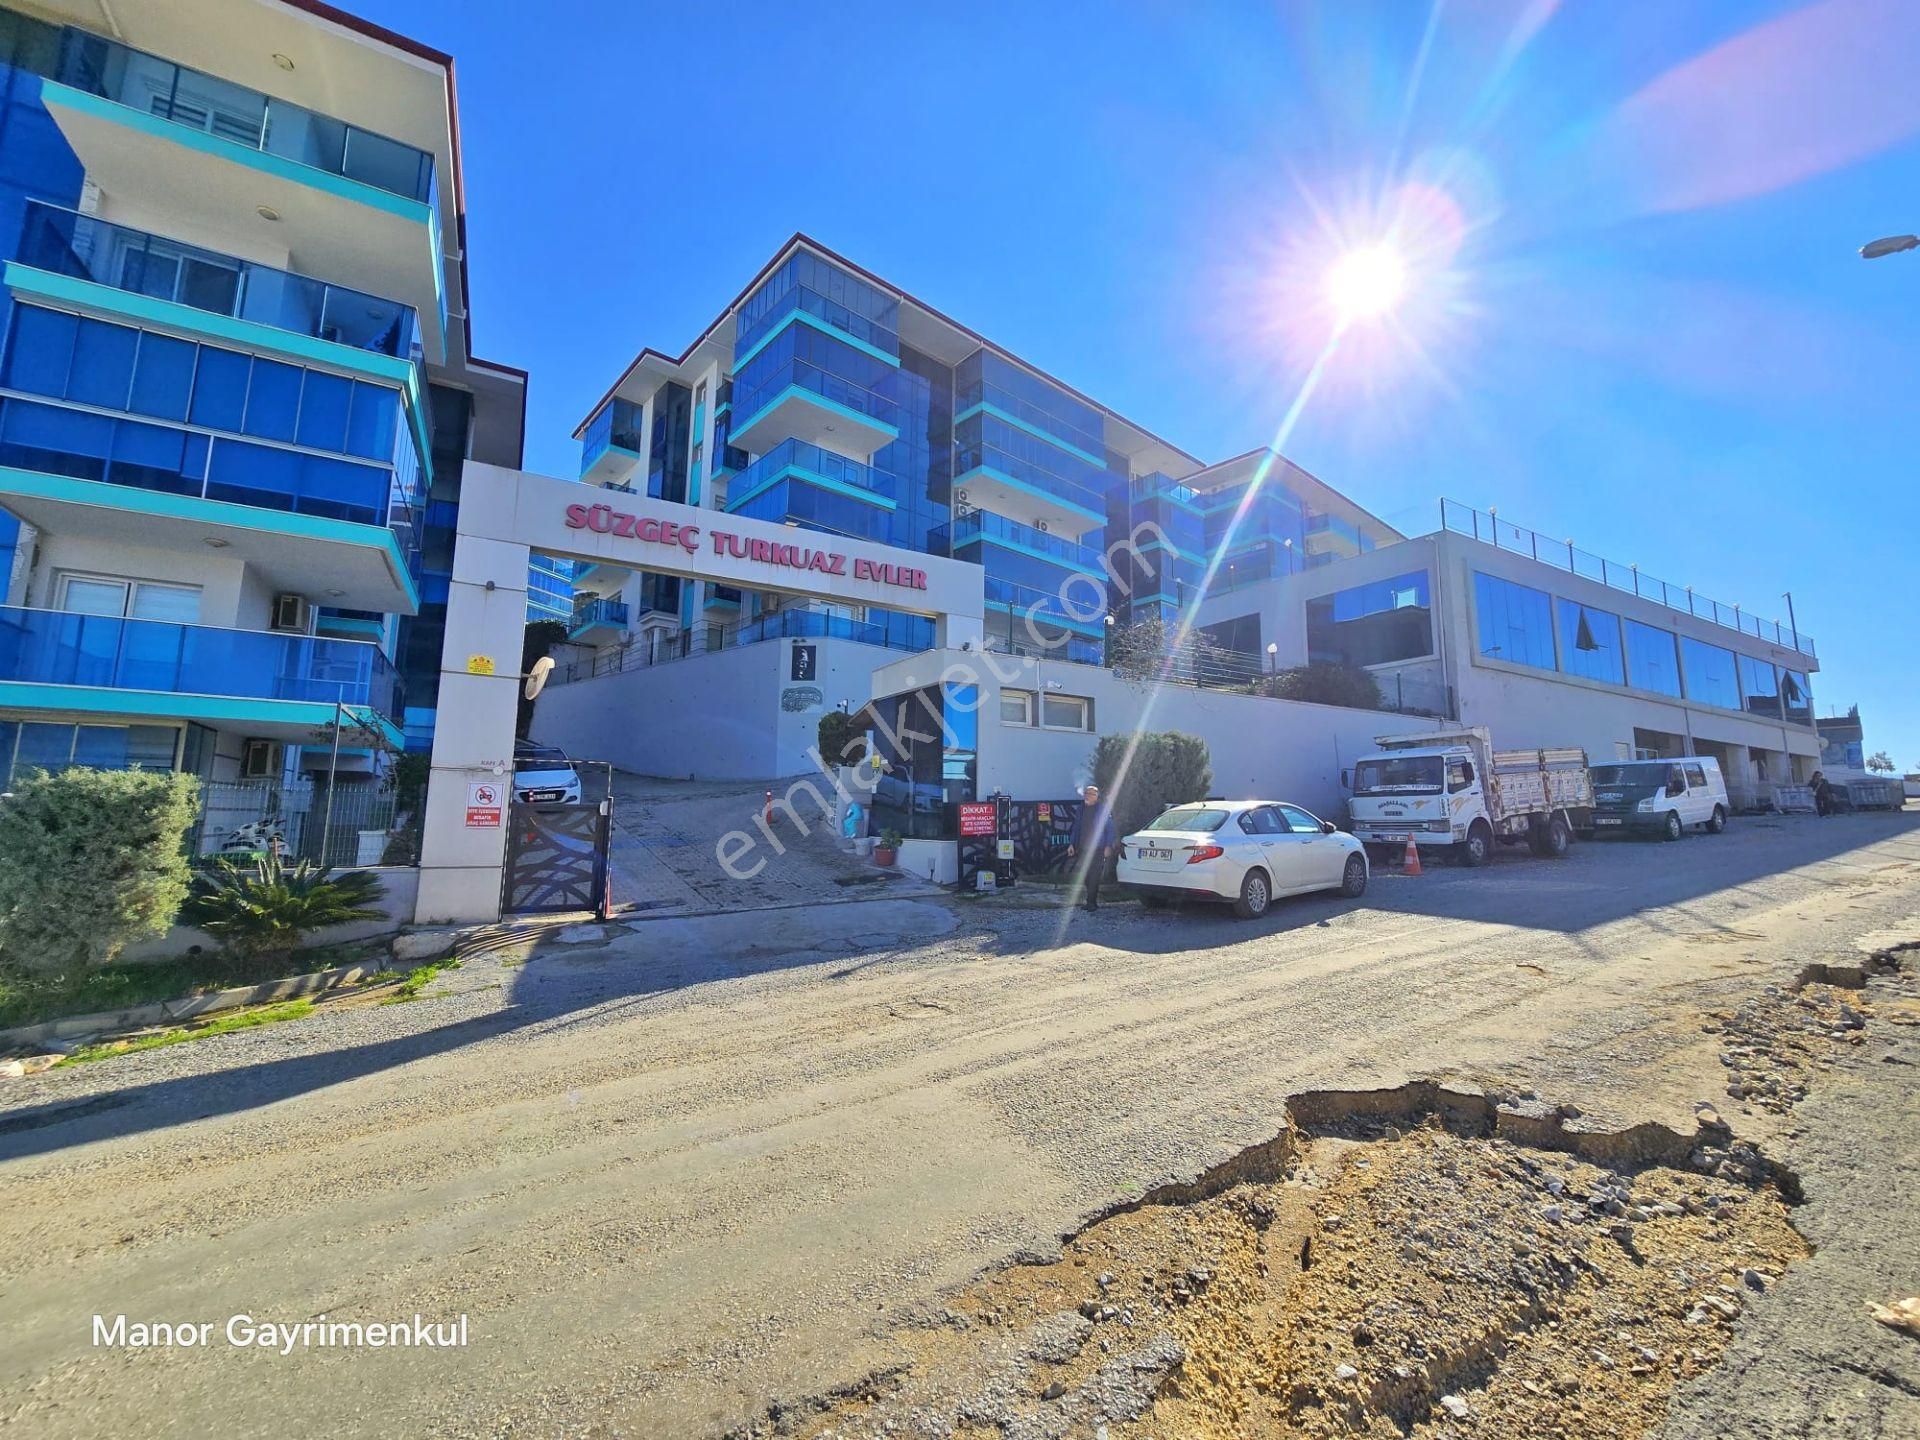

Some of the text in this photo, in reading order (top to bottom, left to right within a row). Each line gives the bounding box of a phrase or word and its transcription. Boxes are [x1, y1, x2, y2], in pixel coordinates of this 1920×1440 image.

[565, 503, 928, 590] SÜZGEÇ TURKUAZ EVLER
